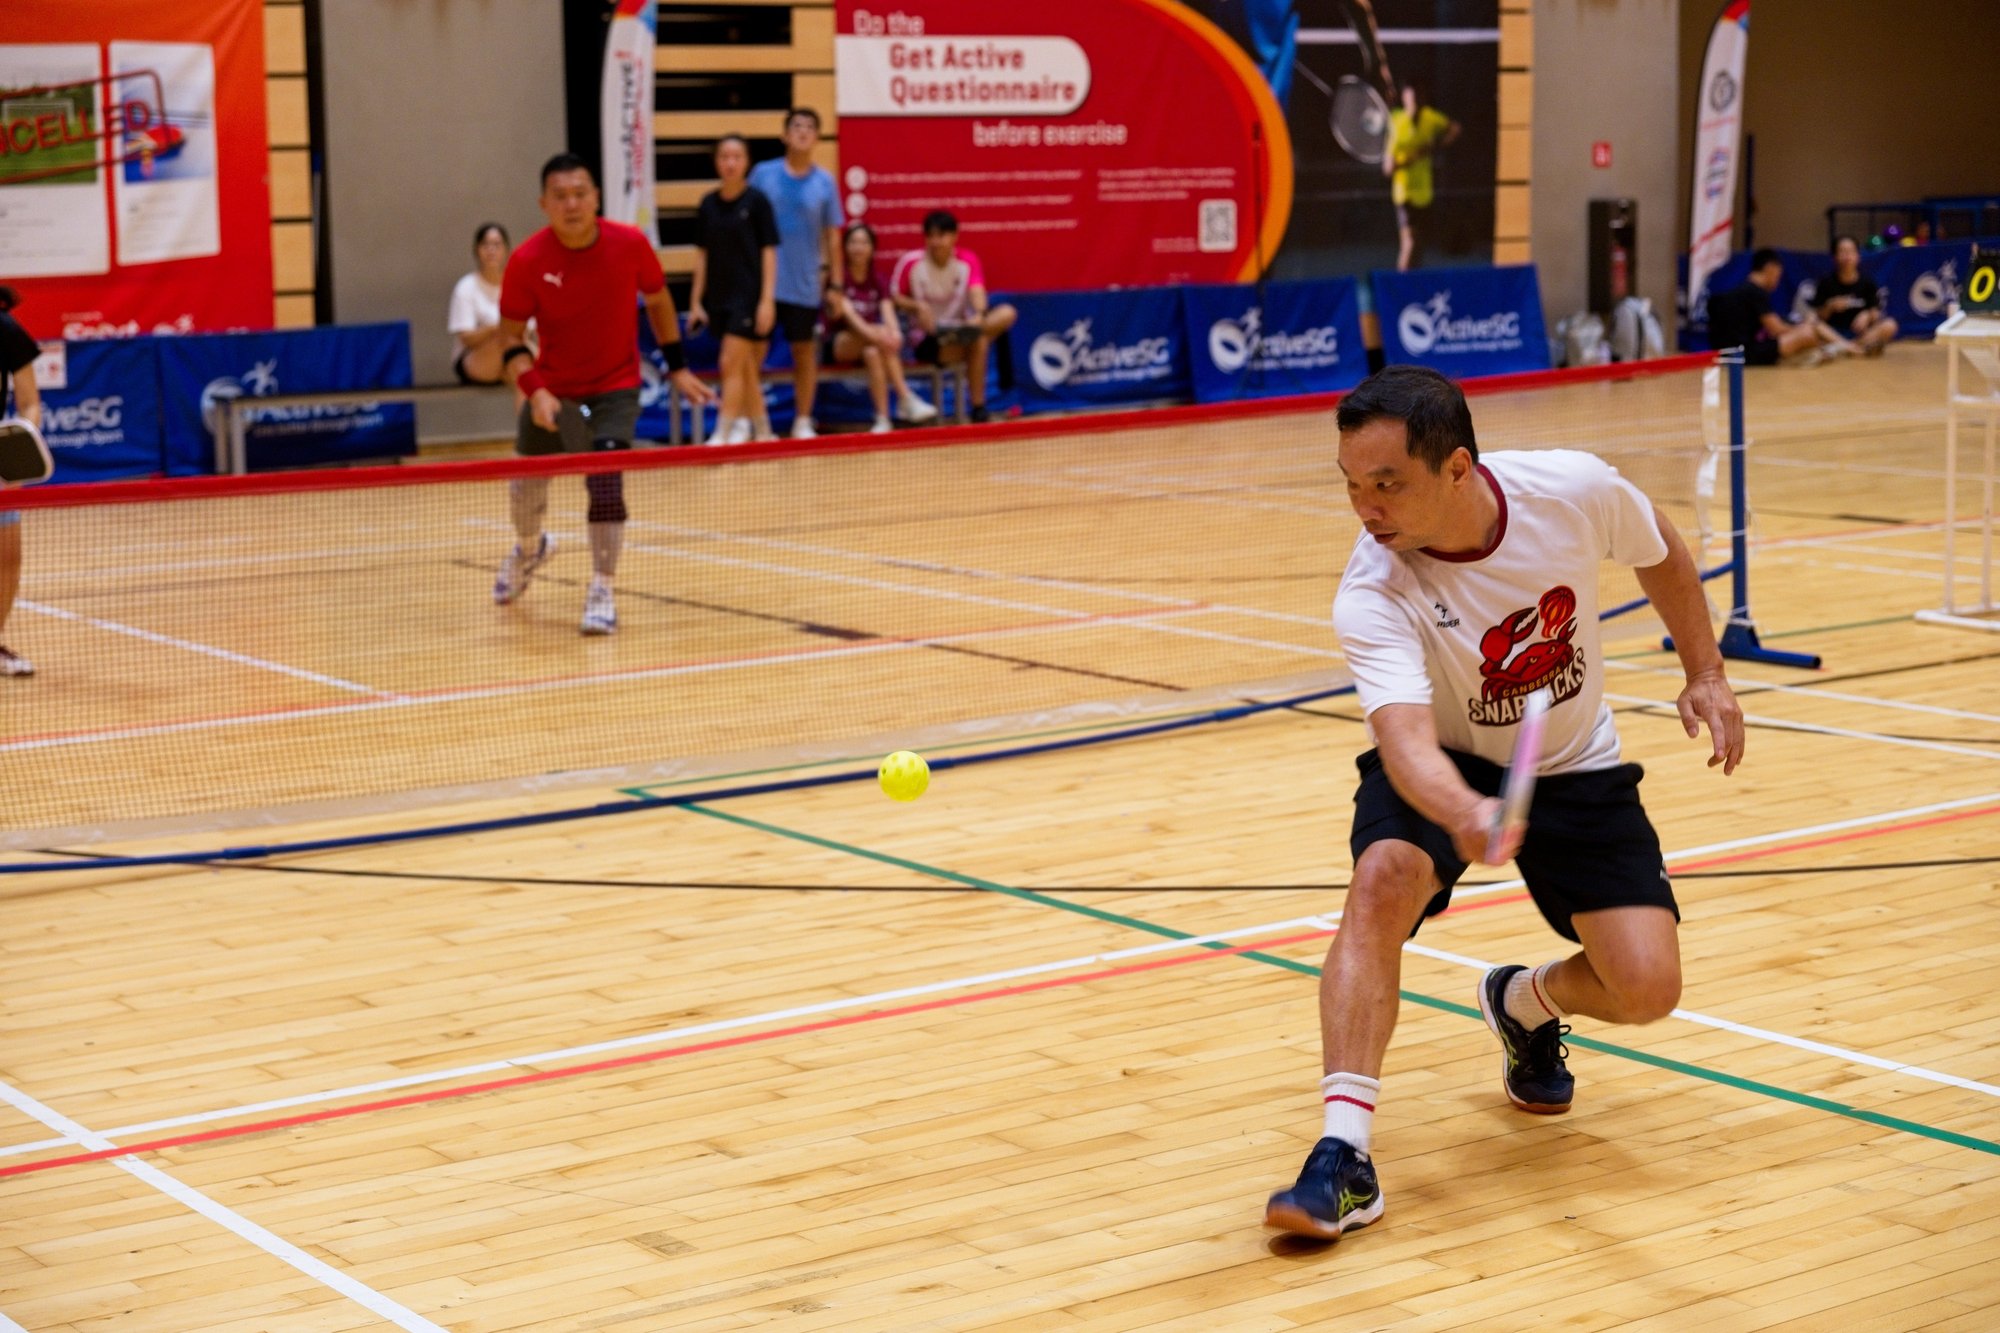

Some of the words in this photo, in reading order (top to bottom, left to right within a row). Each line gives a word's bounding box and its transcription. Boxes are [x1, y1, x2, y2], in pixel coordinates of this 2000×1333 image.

[853, 9, 885, 36] Do
[887, 11, 925, 36] the
[890, 43, 934, 69] Get
[943, 43, 1025, 69] Active
[890, 75, 1077, 108] Questionnaire
[973, 119, 1041, 147] before
[1043, 119, 1128, 146] exercise
[1968, 265, 1996, 303] 0
[1434, 311, 1520, 341] ActiveSG
[1073, 337, 1170, 371] ActiveSG
[1469, 647, 1587, 726] SNAPACKS
[1502, 666, 1562, 697] CANBERRA
